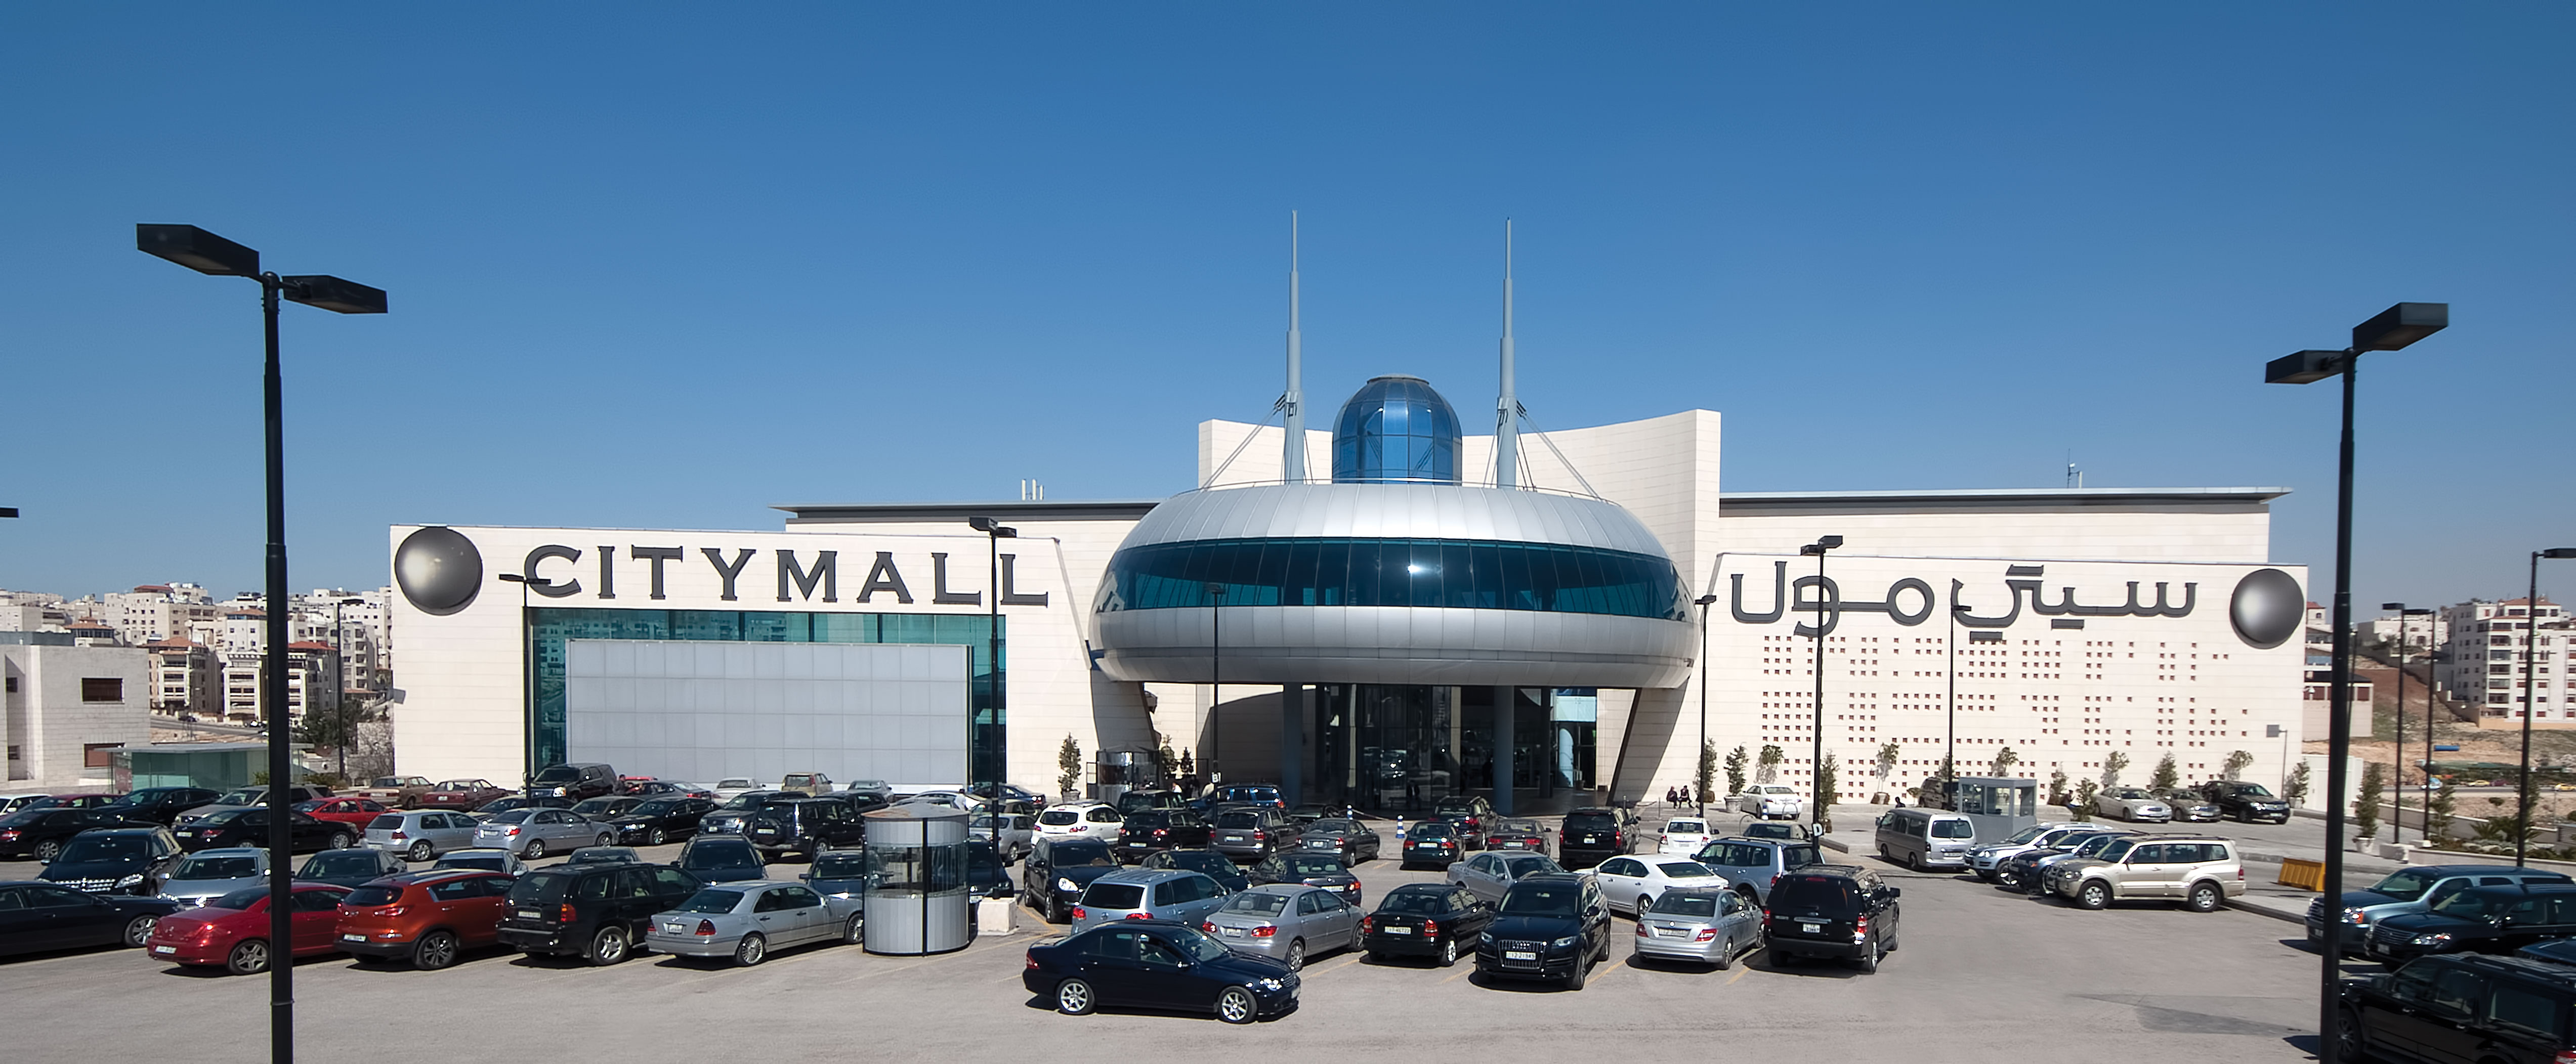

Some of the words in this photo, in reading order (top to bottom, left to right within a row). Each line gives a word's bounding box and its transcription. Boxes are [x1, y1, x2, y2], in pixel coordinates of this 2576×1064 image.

[524, 544, 1048, 607] CITYMALL
[1730, 561, 1934, 637] مول
[1952, 564, 2197, 643] سيتي
[1812, 823, 1823, 836] D
